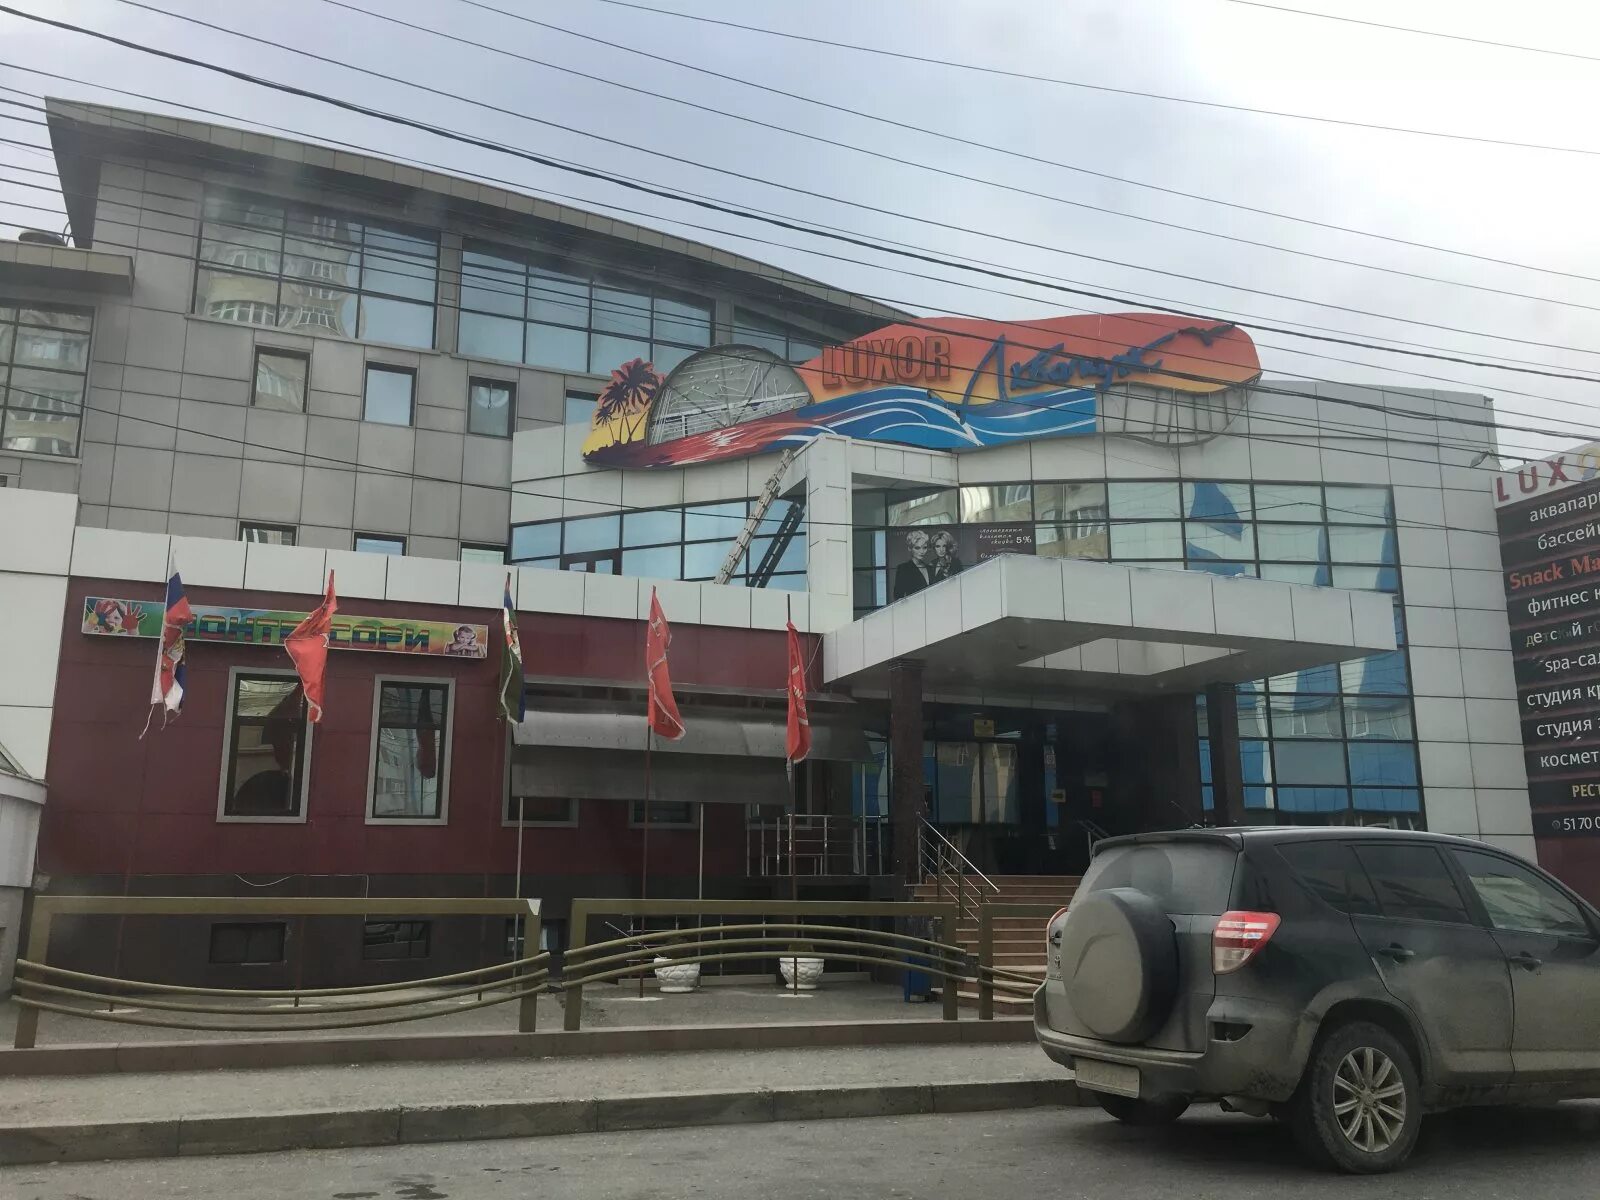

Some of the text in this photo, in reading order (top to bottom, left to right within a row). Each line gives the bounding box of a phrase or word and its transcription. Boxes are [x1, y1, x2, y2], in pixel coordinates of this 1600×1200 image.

[822, 335, 951, 388] LUXOR
[1529, 491, 1600, 522] аквапар
[1015, 535, 1032, 544] 5%
[1509, 562, 1564, 590] Snack
[1528, 590, 1590, 617] фитнес
[1526, 688, 1581, 708] студия
[1536, 719, 1592, 739] студия
[1540, 751, 1600, 768] космет
